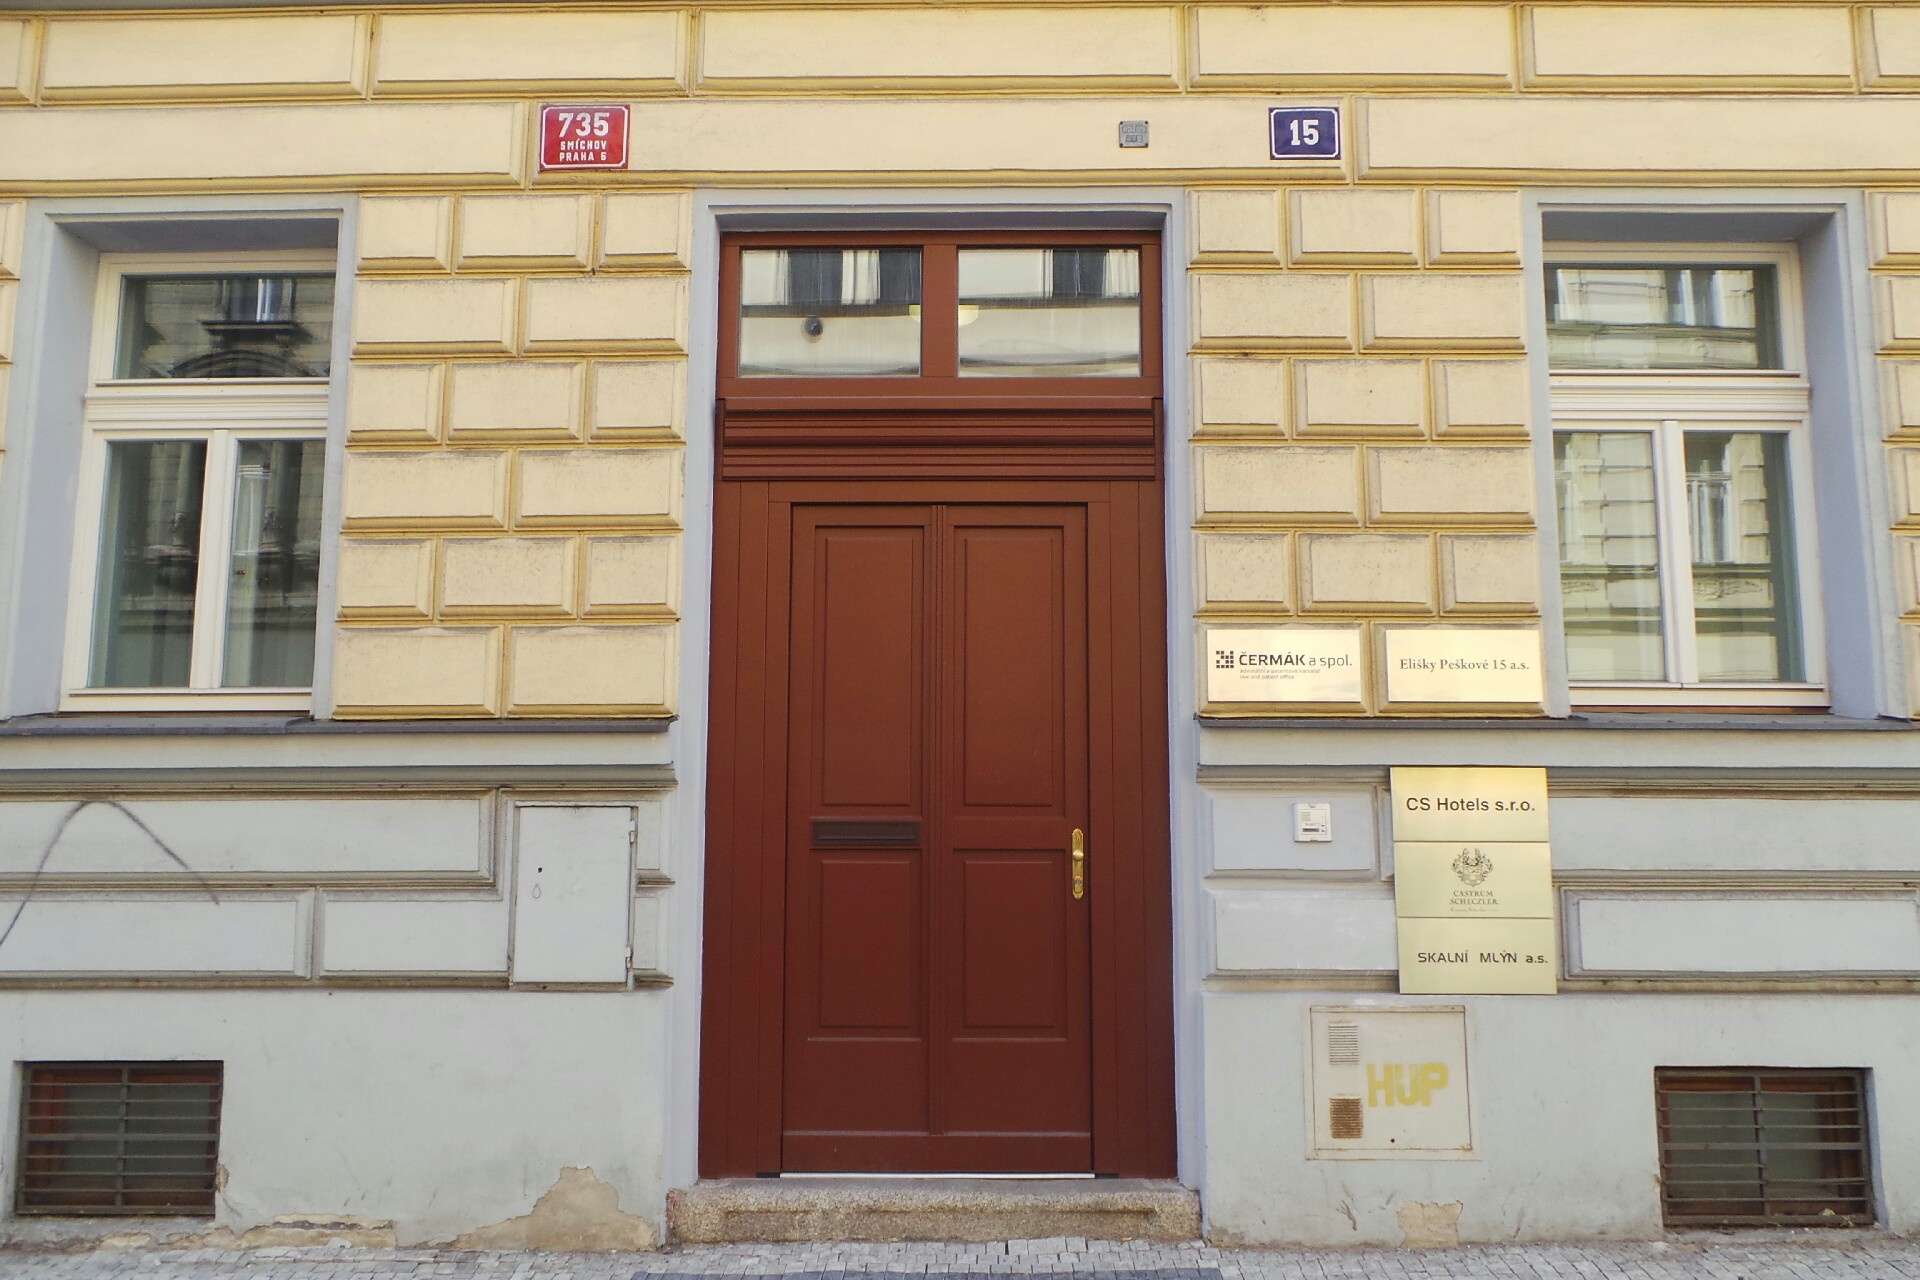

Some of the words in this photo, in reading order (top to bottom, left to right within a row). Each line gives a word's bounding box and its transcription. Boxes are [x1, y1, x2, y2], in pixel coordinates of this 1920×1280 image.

[559, 112, 609, 137] 735
[1289, 119, 1319, 145] 15
[560, 138, 607, 150] SMÍCHOV
[559, 152, 594, 161] PRAHA
[1239, 651, 1306, 666] ČERMÁK
[1308, 657, 1317, 666] a
[1320, 654, 1353, 669] spol.
[1399, 658, 1437, 673] Elišky
[1440, 658, 1489, 670] Peškové
[1493, 659, 1507, 670] 15
[1510, 661, 1530, 670] a.s.
[1406, 797, 1431, 811] CS
[1437, 797, 1489, 811] Hotels
[1495, 800, 1536, 811] s.r.o.
[1418, 949, 1469, 963] SKALNÍ
[1480, 949, 1517, 963] MLÝN
[1525, 954, 1548, 964] a.s.
[1366, 1062, 1449, 1108] HUP
